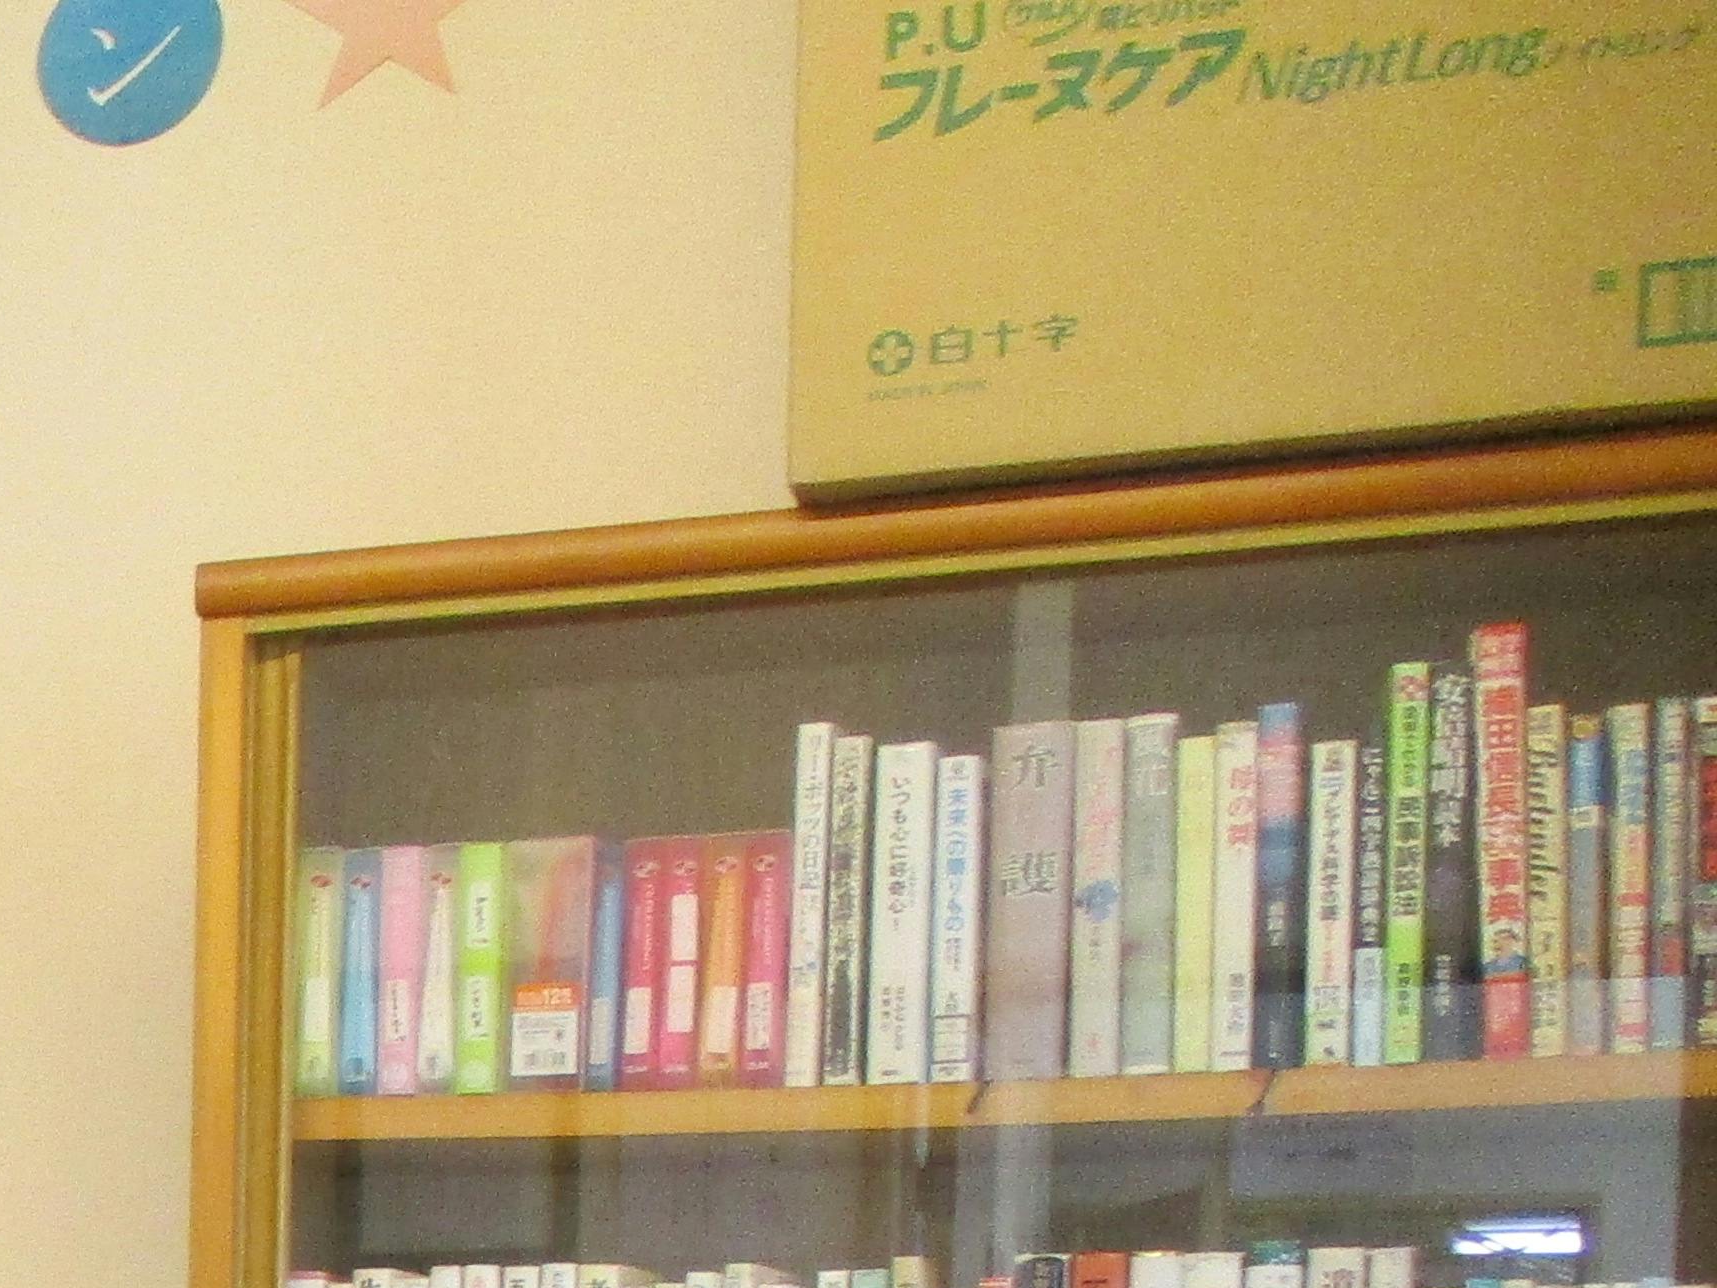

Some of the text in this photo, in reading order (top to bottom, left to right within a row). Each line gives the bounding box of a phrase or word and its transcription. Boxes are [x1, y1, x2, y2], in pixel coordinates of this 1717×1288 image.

[928, 312, 1080, 366] 白十字
[1000, 744, 1061, 897] 介護
